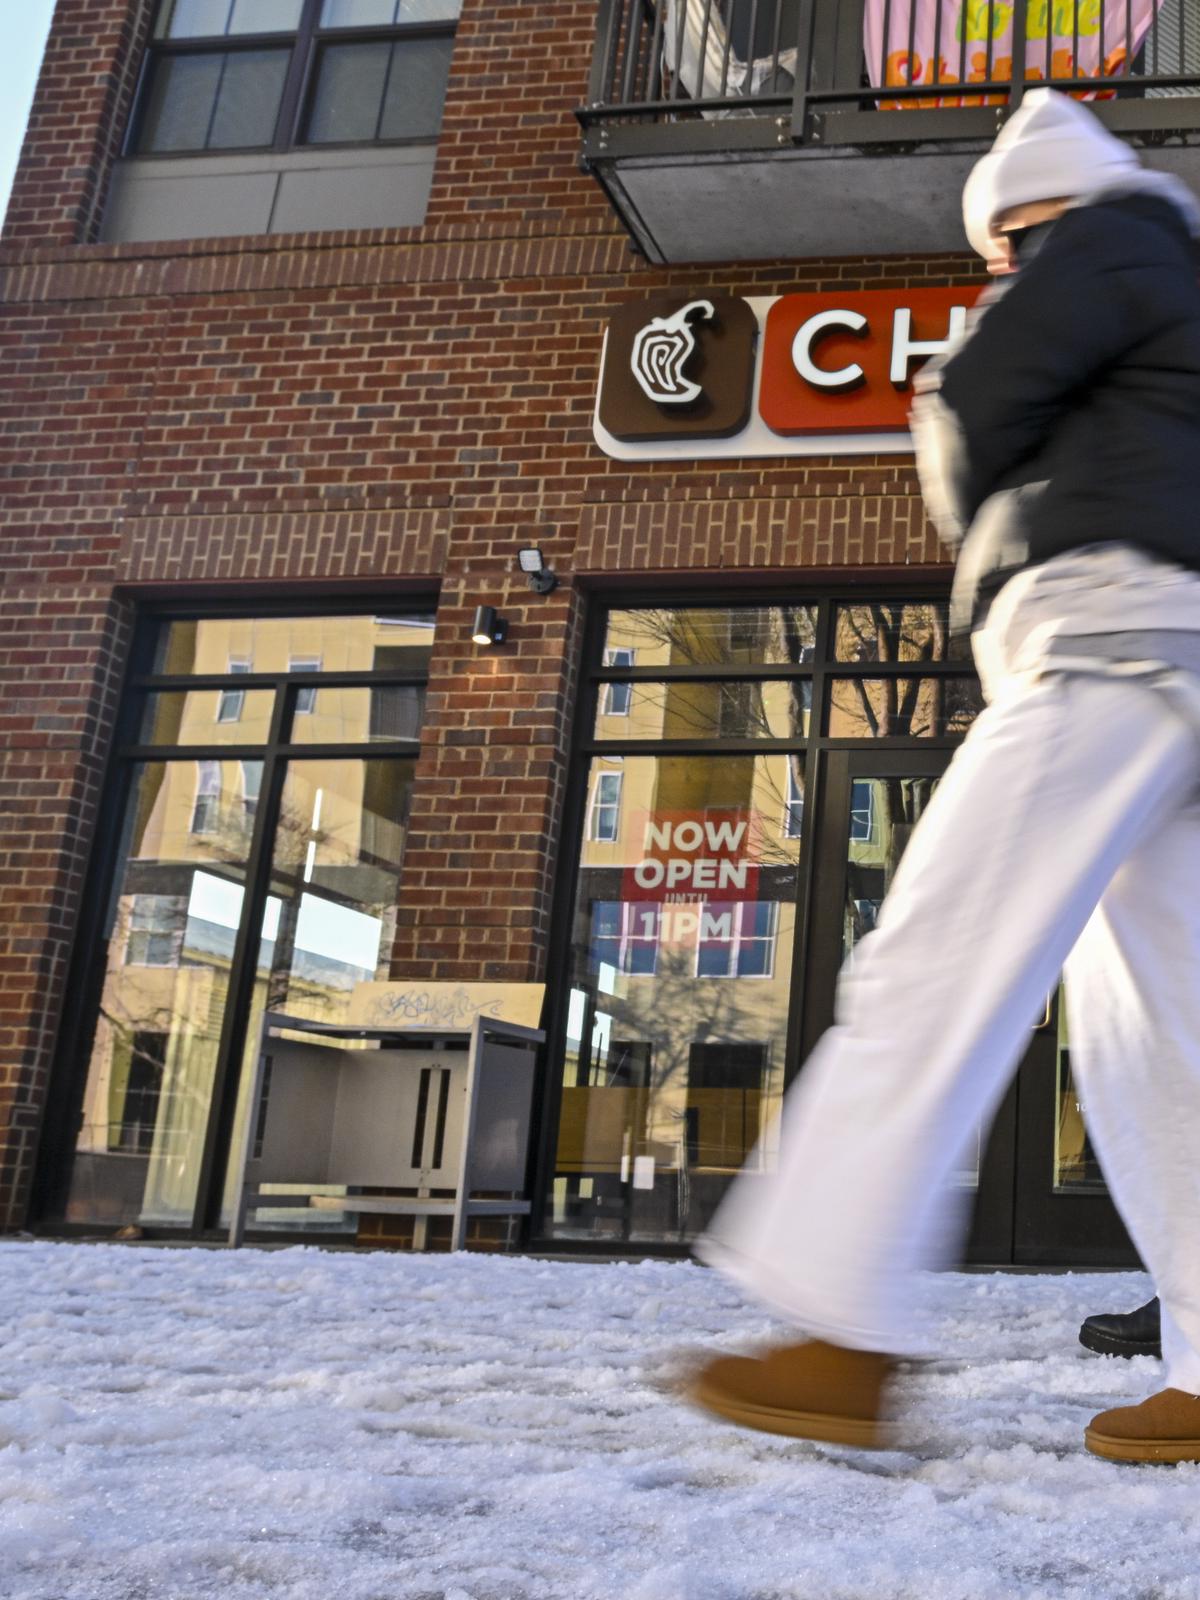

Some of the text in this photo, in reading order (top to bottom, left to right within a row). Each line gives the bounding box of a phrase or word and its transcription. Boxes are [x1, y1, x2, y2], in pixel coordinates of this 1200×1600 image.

[643, 820, 748, 853] NOW
[633, 857, 748, 889] OPEN
[665, 892, 712, 907] UNTIL
[640, 910, 732, 943] 11PM
